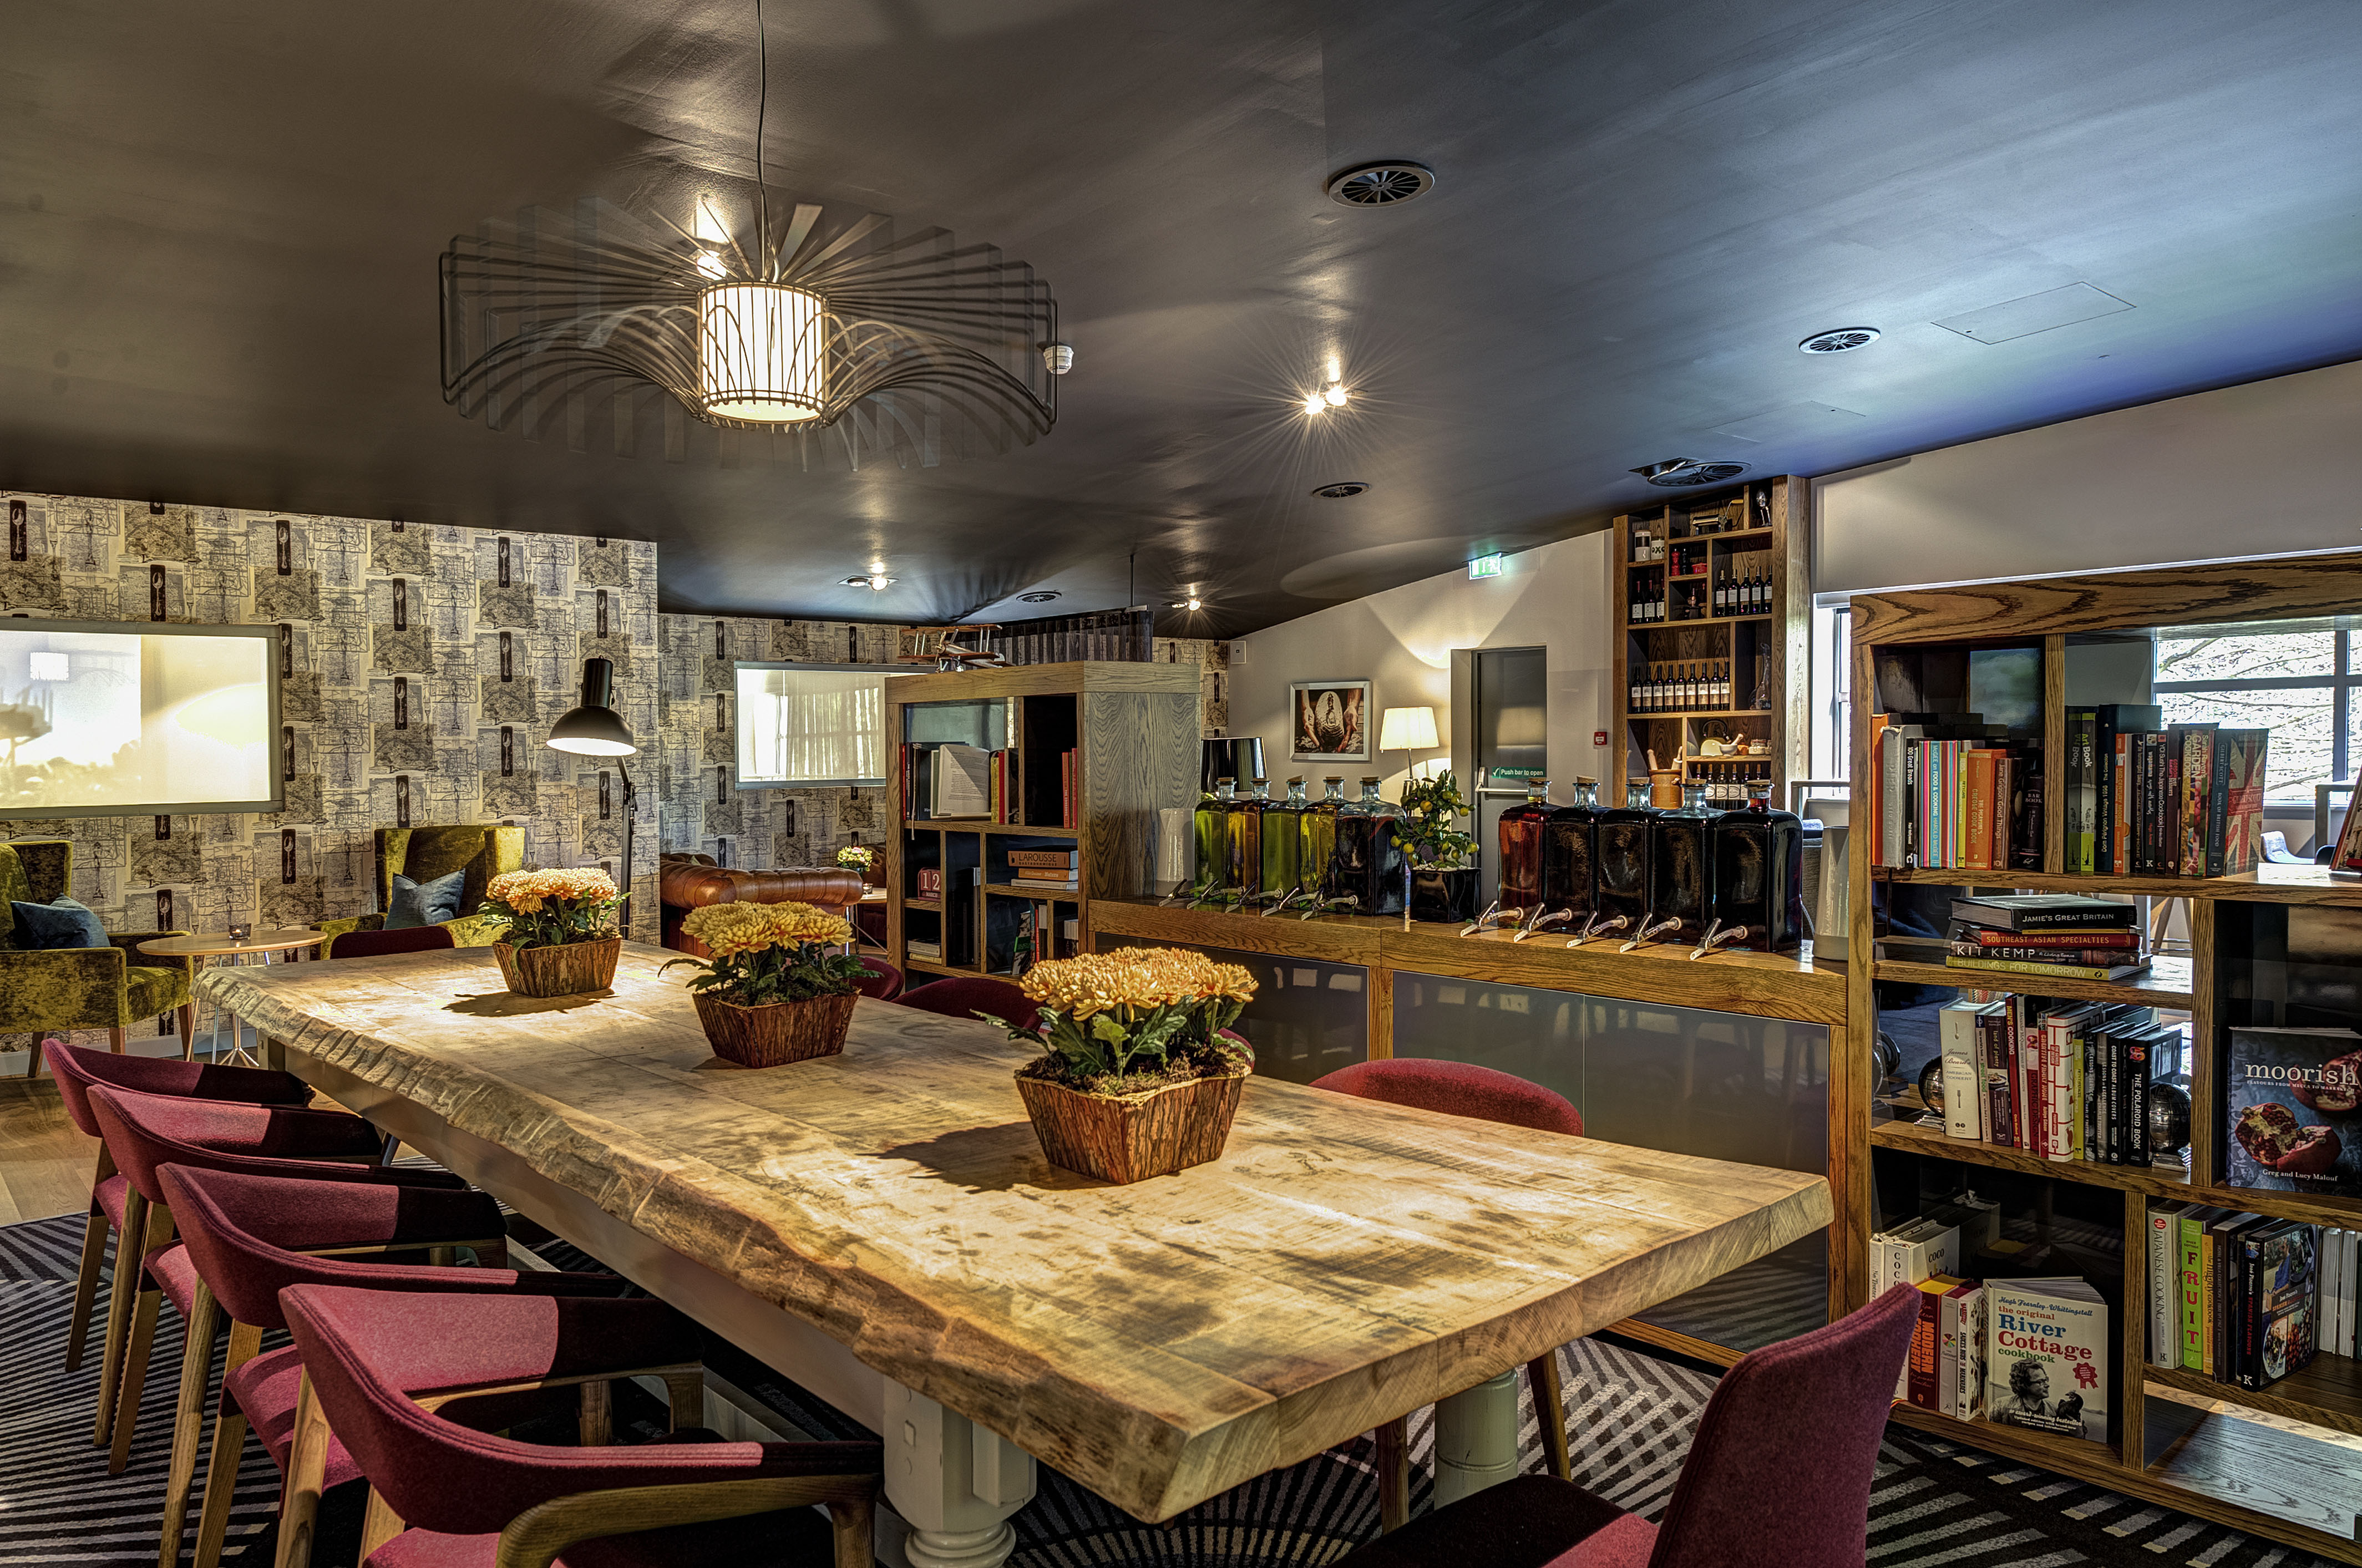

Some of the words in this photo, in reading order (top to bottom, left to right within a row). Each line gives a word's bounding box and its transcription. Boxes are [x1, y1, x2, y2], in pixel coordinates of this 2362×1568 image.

[2082, 746, 2092, 768] Book
[2183, 734, 2192, 778] COOKBOOK
[2191, 734, 2202, 779] GARDEN
[1018, 852, 1057, 862] LAROUSSE
[1956, 945, 1984, 956] KIT
[1991, 947, 2036, 959] KEMP
[1957, 959, 2006, 971] BUILDINGS
[2009, 962, 2029, 972] FOR
[2030, 964, 2086, 977] TOMORROW
[1947, 1048, 1968, 1056] James
[2245, 1064, 2359, 1086] moorish
[2295, 1171, 2311, 1180] Lucy
[2313, 1174, 2339, 1182] Malouf
[1928, 1248, 1944, 1263] COCO
[2152, 1230, 2165, 1275] JAPANESE
[1998, 1296, 2016, 1305] Hugh
[2017, 1298, 2093, 1317] Fearnley-Whittingstall
[2155, 1275, 2166, 1321] COOKING
[2183, 1251, 2199, 1345] FRUIT
[1998, 1305, 2014, 1314] the
[2016, 1309, 2055, 1321] original
[1998, 1313, 2066, 1338] River
[1910, 1318, 1922, 1373] COOKERY
[1920, 1320, 1934, 1374] MODERN
[1998, 1330, 2092, 1362] Cottage
[1998, 1347, 2055, 1363] cookbook
[2243, 1374, 2253, 1386] K
